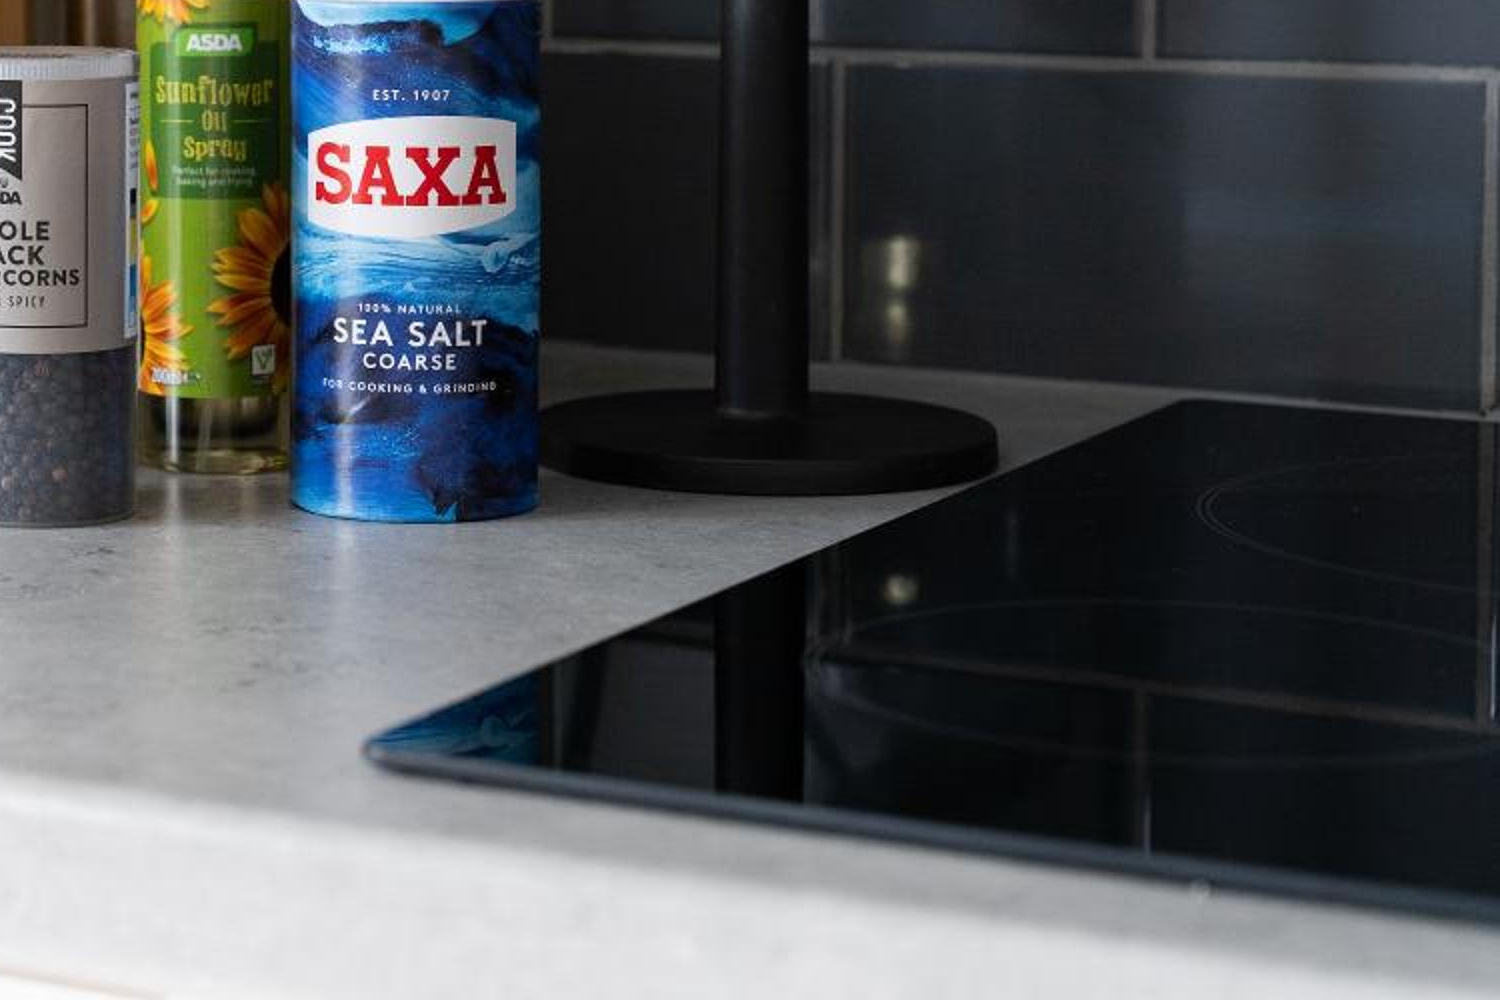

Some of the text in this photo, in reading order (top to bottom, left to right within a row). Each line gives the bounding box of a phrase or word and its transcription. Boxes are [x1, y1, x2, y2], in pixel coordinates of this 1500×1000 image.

[186, 33, 243, 52] ASDA
[156, 75, 274, 105] Sunflower
[373, 89, 450, 101] EST. 1907
[183, 135, 247, 162] Spray
[315, 141, 507, 207] SAXA
[8, 295, 46, 308] SPICY
[358, 303, 462, 315] 100% NATURAL
[333, 317, 488, 347] SEA SALT
[363, 352, 457, 371] COARSE
[323, 377, 343, 390] FOR
[349, 380, 414, 394] COOKING
[419, 382, 427, 393] &
